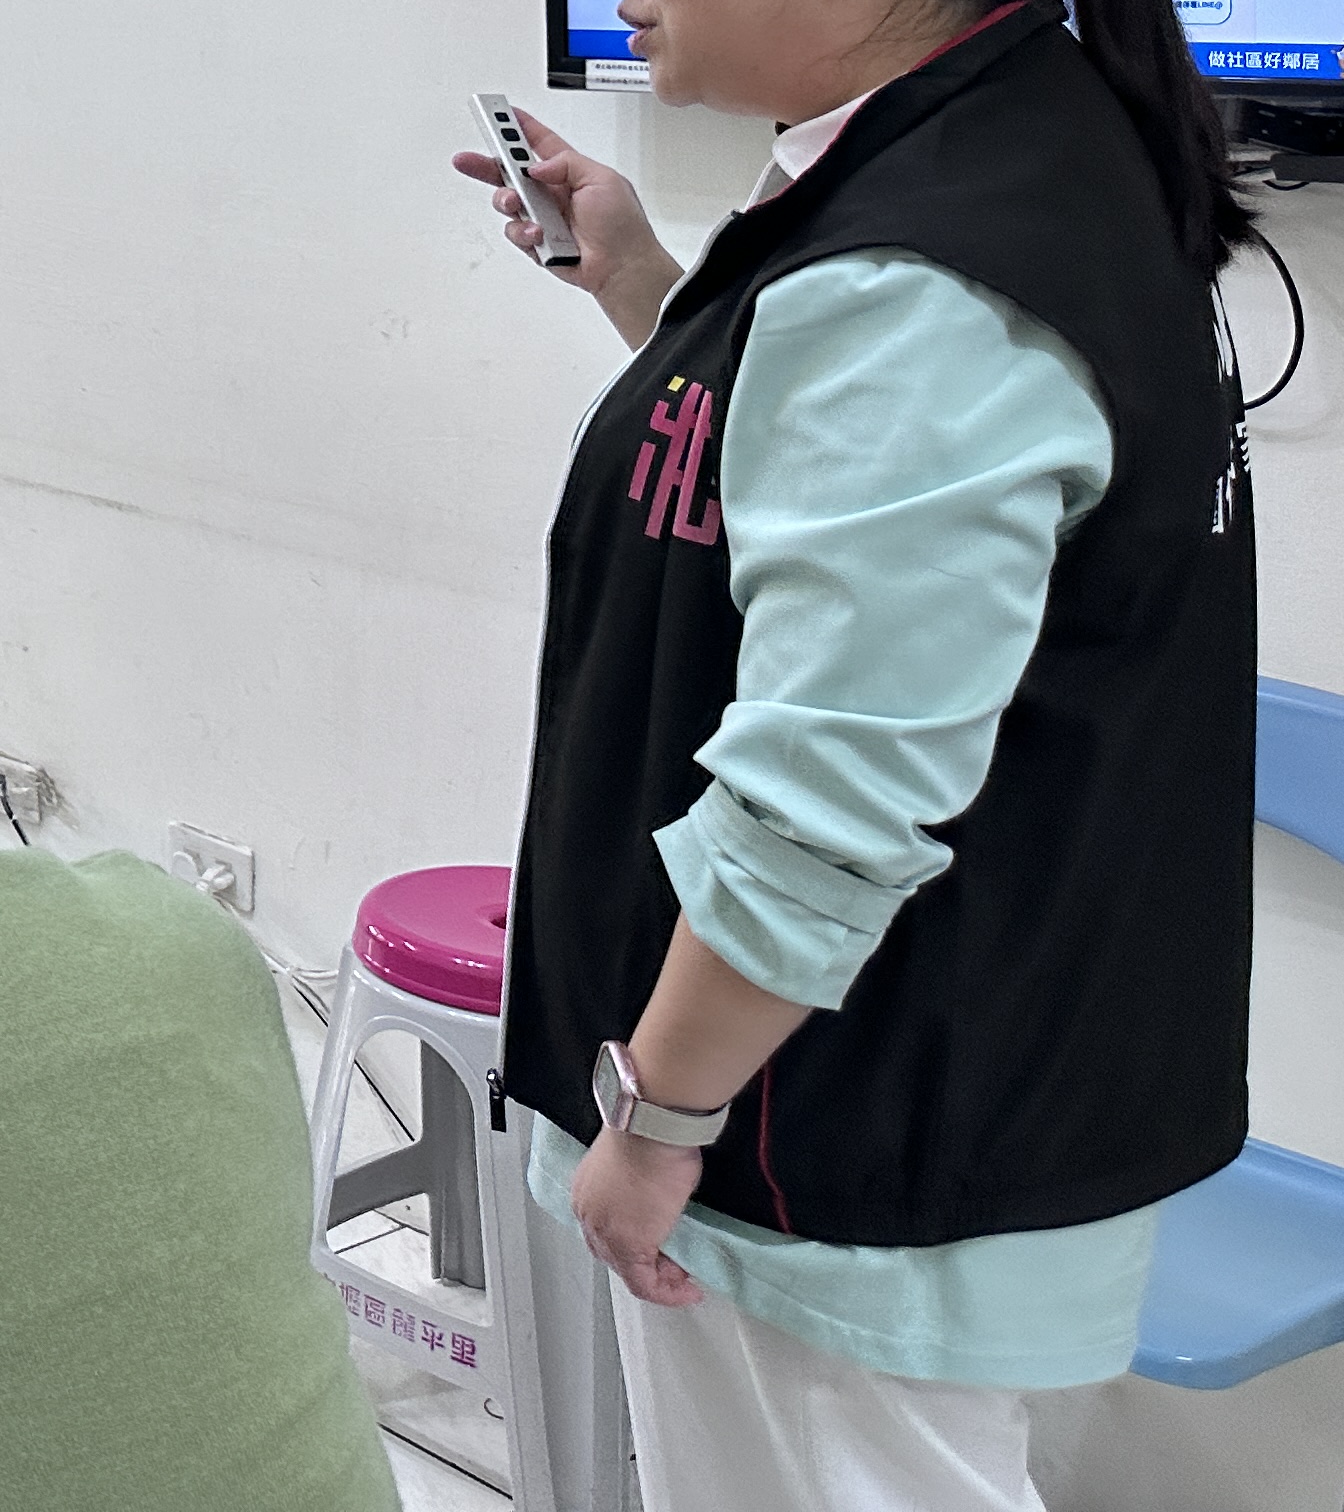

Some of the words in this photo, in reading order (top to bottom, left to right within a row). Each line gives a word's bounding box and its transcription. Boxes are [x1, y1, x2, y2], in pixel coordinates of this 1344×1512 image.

[1208, 50, 1320, 71] 做社區好鄰居
